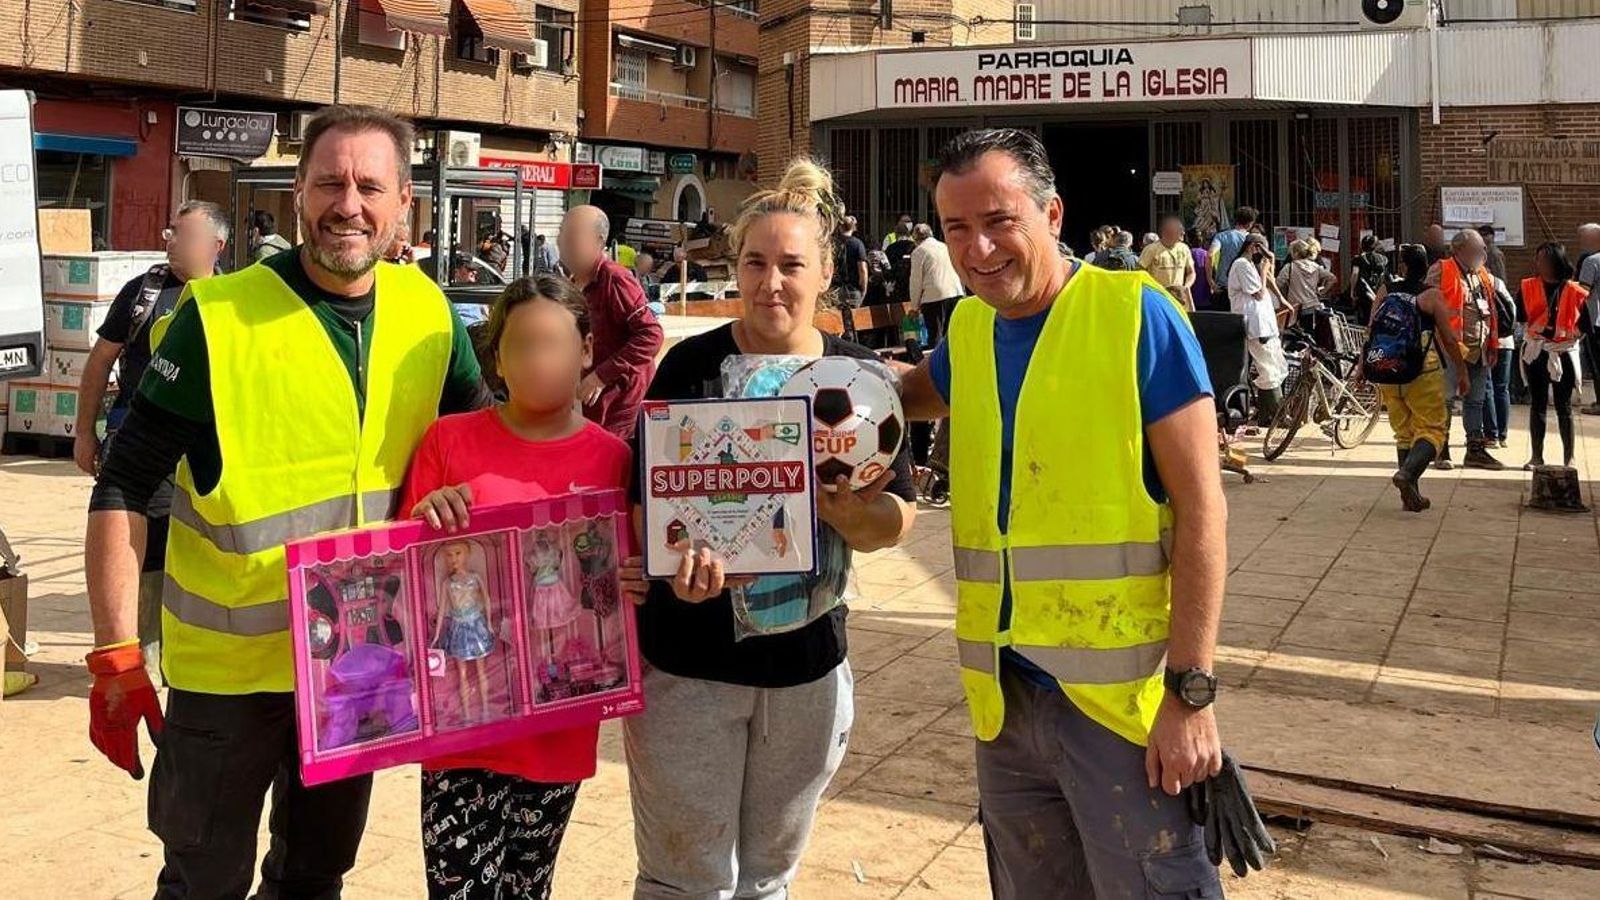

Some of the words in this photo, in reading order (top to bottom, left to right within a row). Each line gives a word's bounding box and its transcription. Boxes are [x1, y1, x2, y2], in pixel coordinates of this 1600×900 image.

[978, 48, 1134, 70] PARROQUIA
[974, 73, 1052, 102] MADRE
[1063, 71, 1091, 99] DE
[1102, 70, 1131, 98] LA
[1143, 67, 1228, 97] IGLESIA
[813, 437, 857, 454] CUP
[653, 465, 801, 493] SUPERPOLY
